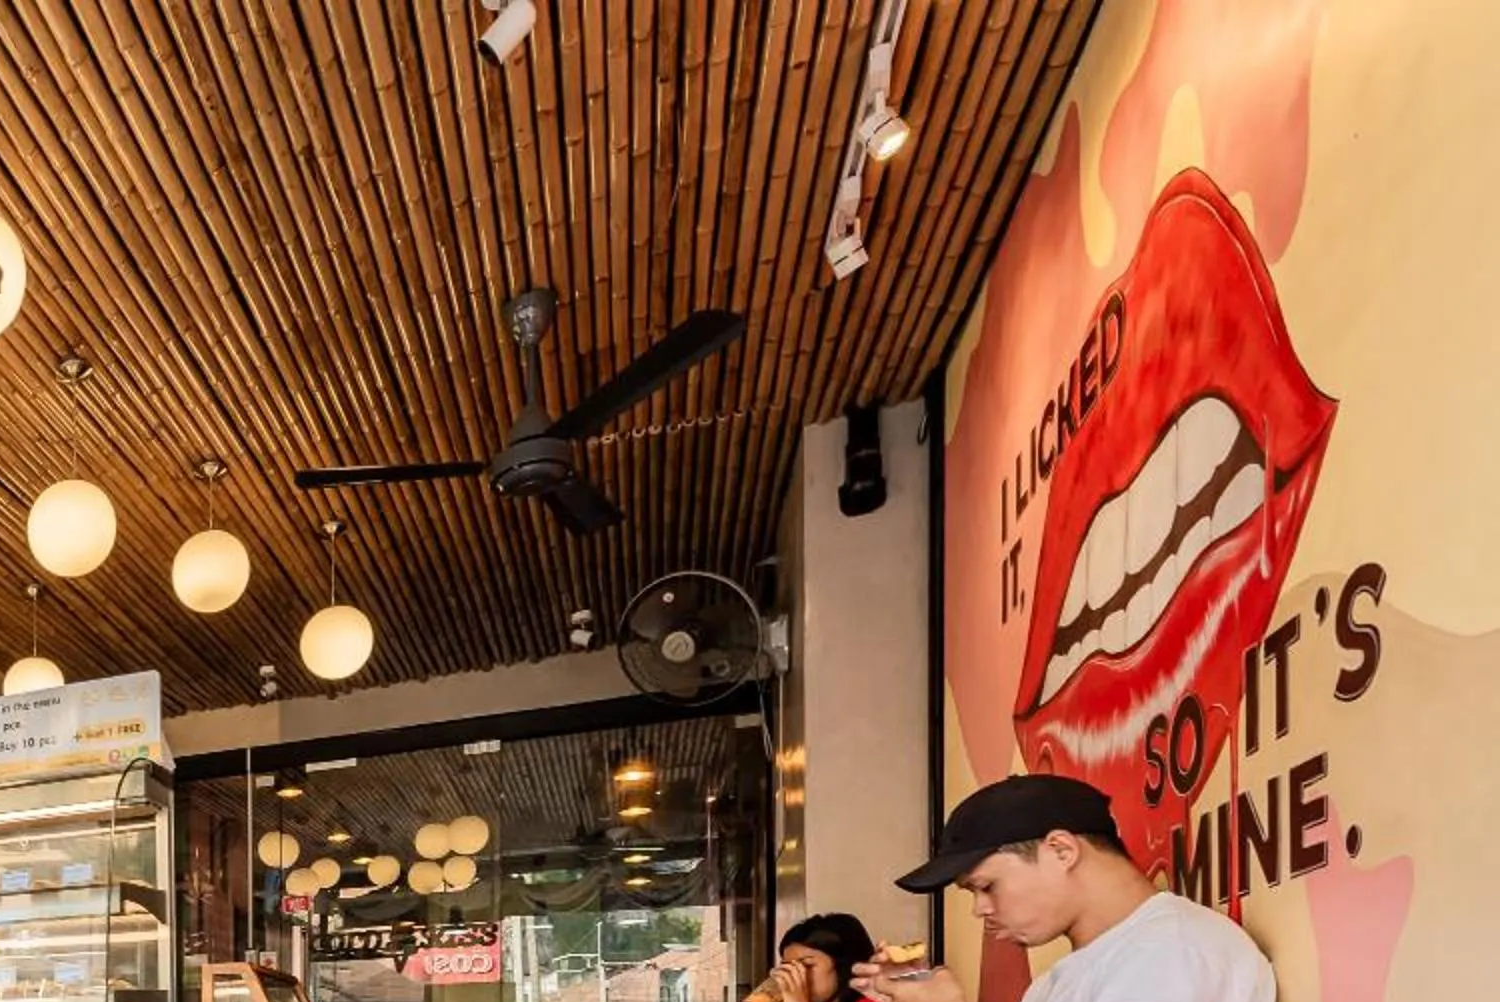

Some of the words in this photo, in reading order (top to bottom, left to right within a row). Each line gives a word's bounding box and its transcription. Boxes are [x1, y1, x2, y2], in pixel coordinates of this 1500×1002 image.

[1000, 478, 1009, 542] I
[1015, 291, 1127, 522] LICKED
[23, 737, 35, 748] 10
[1144, 694, 1206, 808] SO
[1244, 562, 1388, 759] IT'S
[1171, 752, 1363, 909] MINE.
